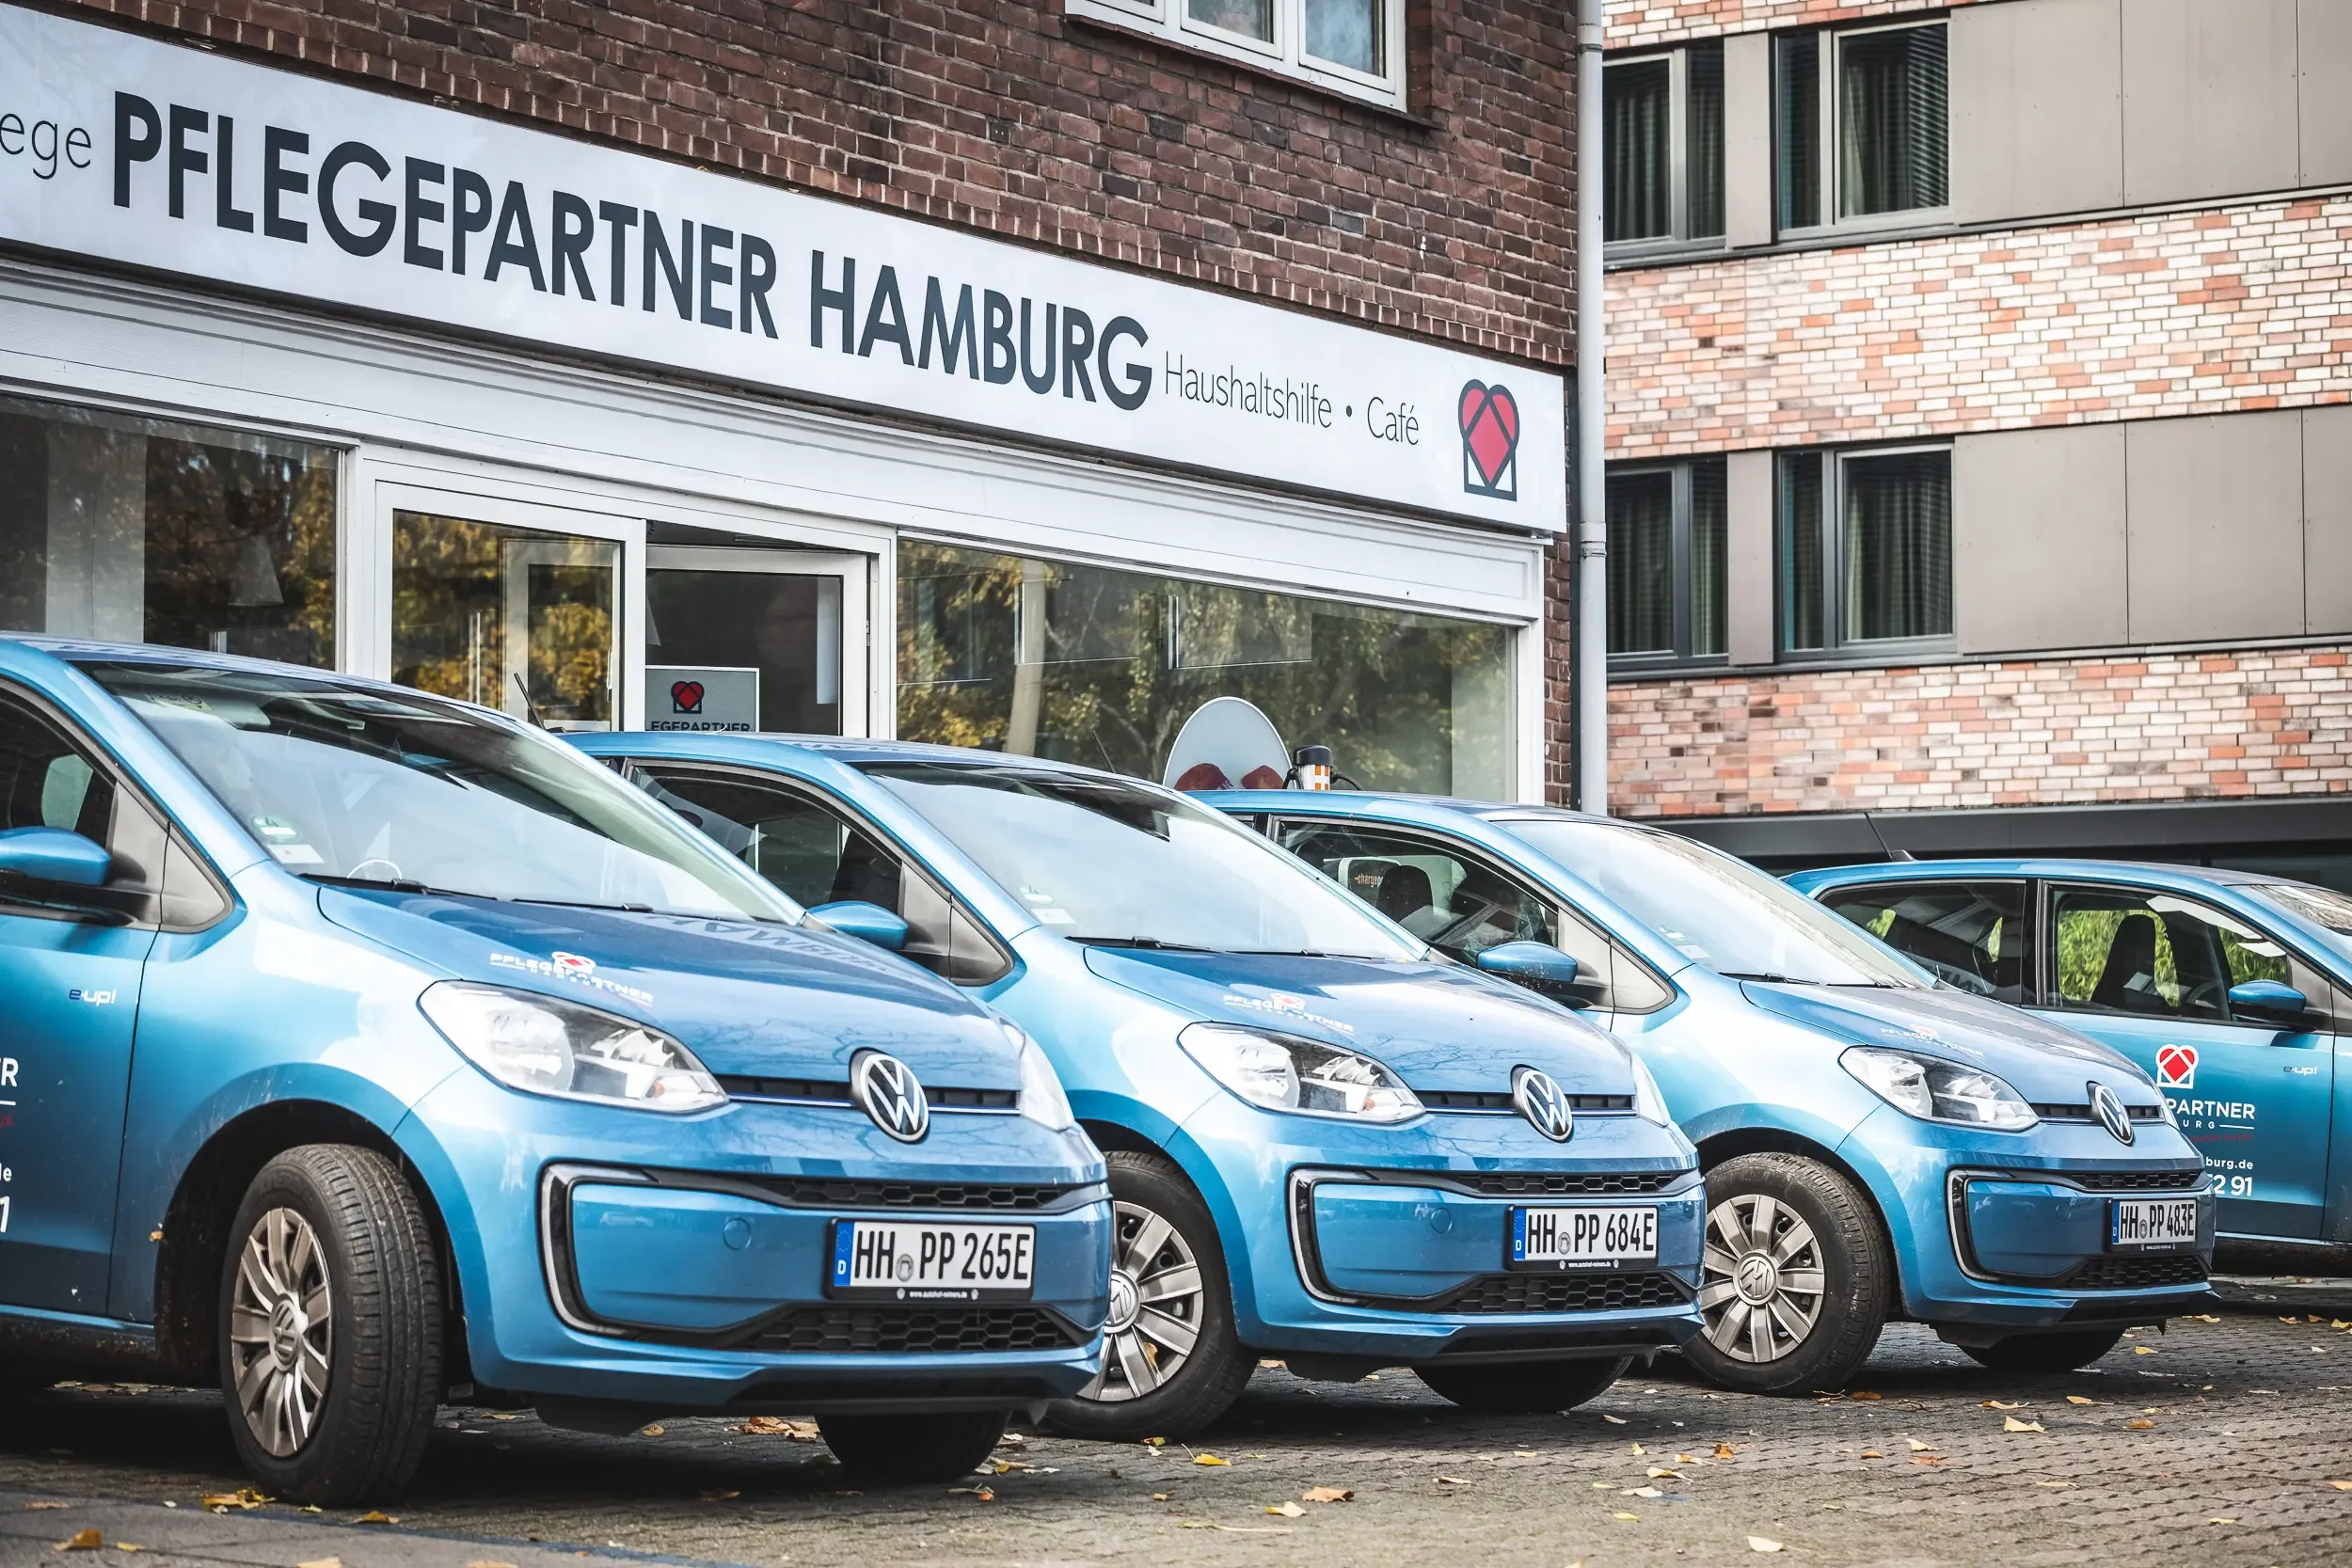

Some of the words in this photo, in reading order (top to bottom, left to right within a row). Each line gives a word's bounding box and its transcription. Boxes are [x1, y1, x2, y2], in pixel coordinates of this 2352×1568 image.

[0, 114, 92, 181] ege
[114, 91, 779, 340] PFLEGEPARTNER
[811, 250, 1152, 411] HAMBURG
[1166, 351, 1332, 429] Haushaltshilfe
[1367, 396, 1419, 446] Café
[2166, 1098, 2256, 1120] PARTNER
[2205, 1156, 2253, 1170] burg.de
[2207, 1174, 2226, 1195] 2
[2231, 1176, 2252, 1196] 91
[1527, 1214, 1556, 1253] HH
[1574, 1214, 1600, 1253] PP
[1605, 1213, 1655, 1252] 684E
[2121, 1206, 2138, 1239] HH
[2150, 1205, 2164, 1238] PP
[2167, 1204, 2195, 1237] 483E
[837, 1259, 847, 1275] D
[854, 1230, 896, 1278] HH
[919, 1232, 956, 1279] PP
[961, 1233, 1030, 1280] 265E
